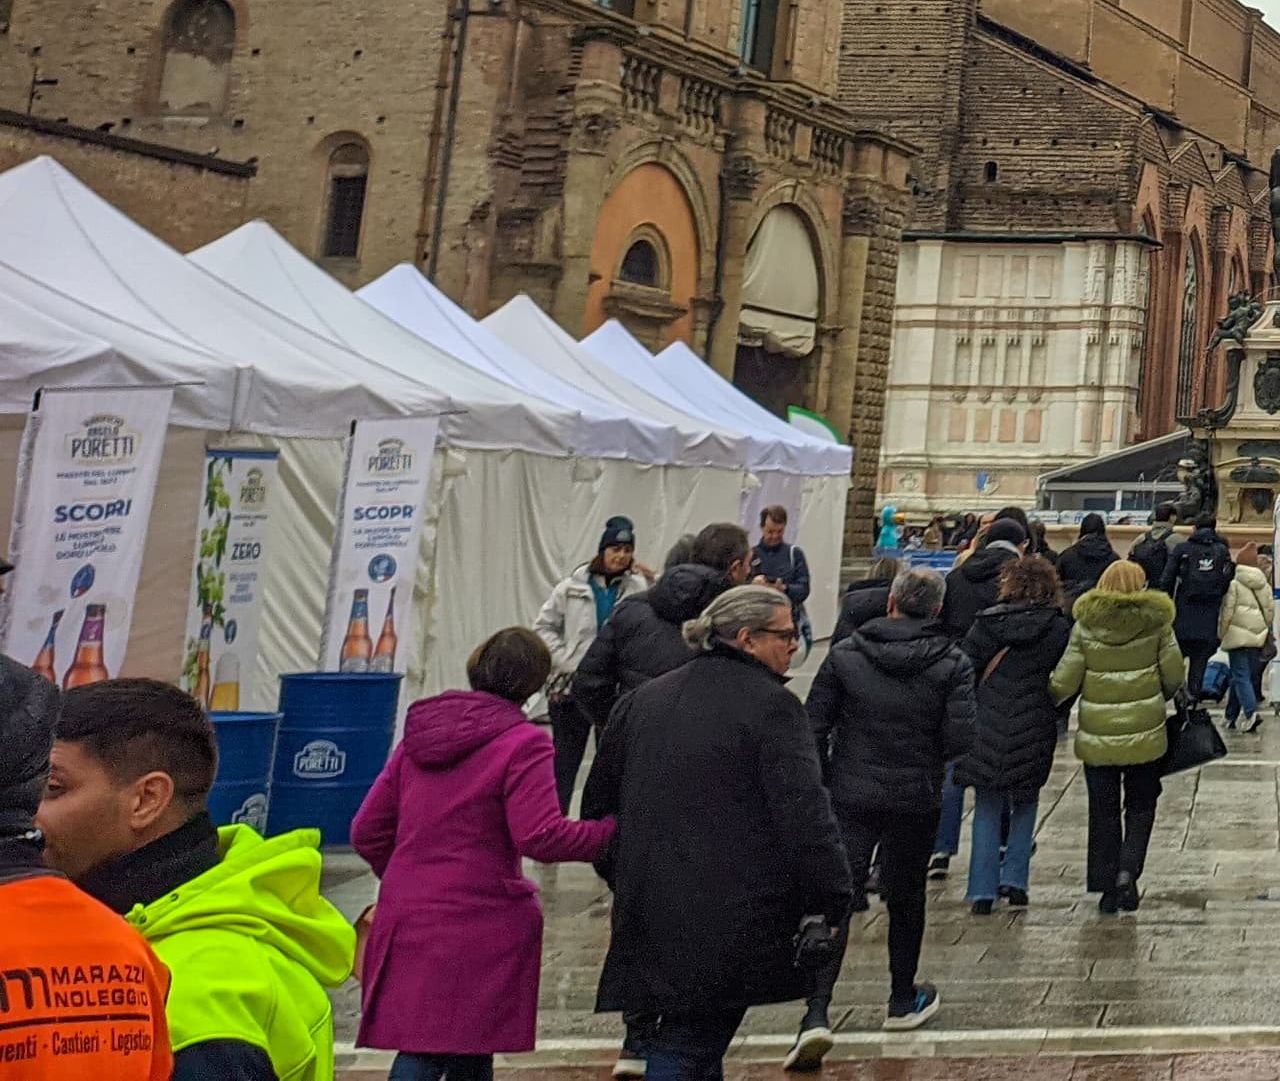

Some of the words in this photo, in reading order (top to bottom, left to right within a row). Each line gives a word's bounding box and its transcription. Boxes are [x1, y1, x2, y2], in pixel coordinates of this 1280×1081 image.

[71, 436, 134, 459] PORETTI
[54, 499, 133, 523] SCOPRI
[353, 504, 416, 521] SCOPR
[230, 541, 261, 561] ZERO
[51, 964, 146, 986] MARAZZI
[53, 988, 149, 1008] NOLEGGIO
[52, 1031, 99, 1056] Cantieri
